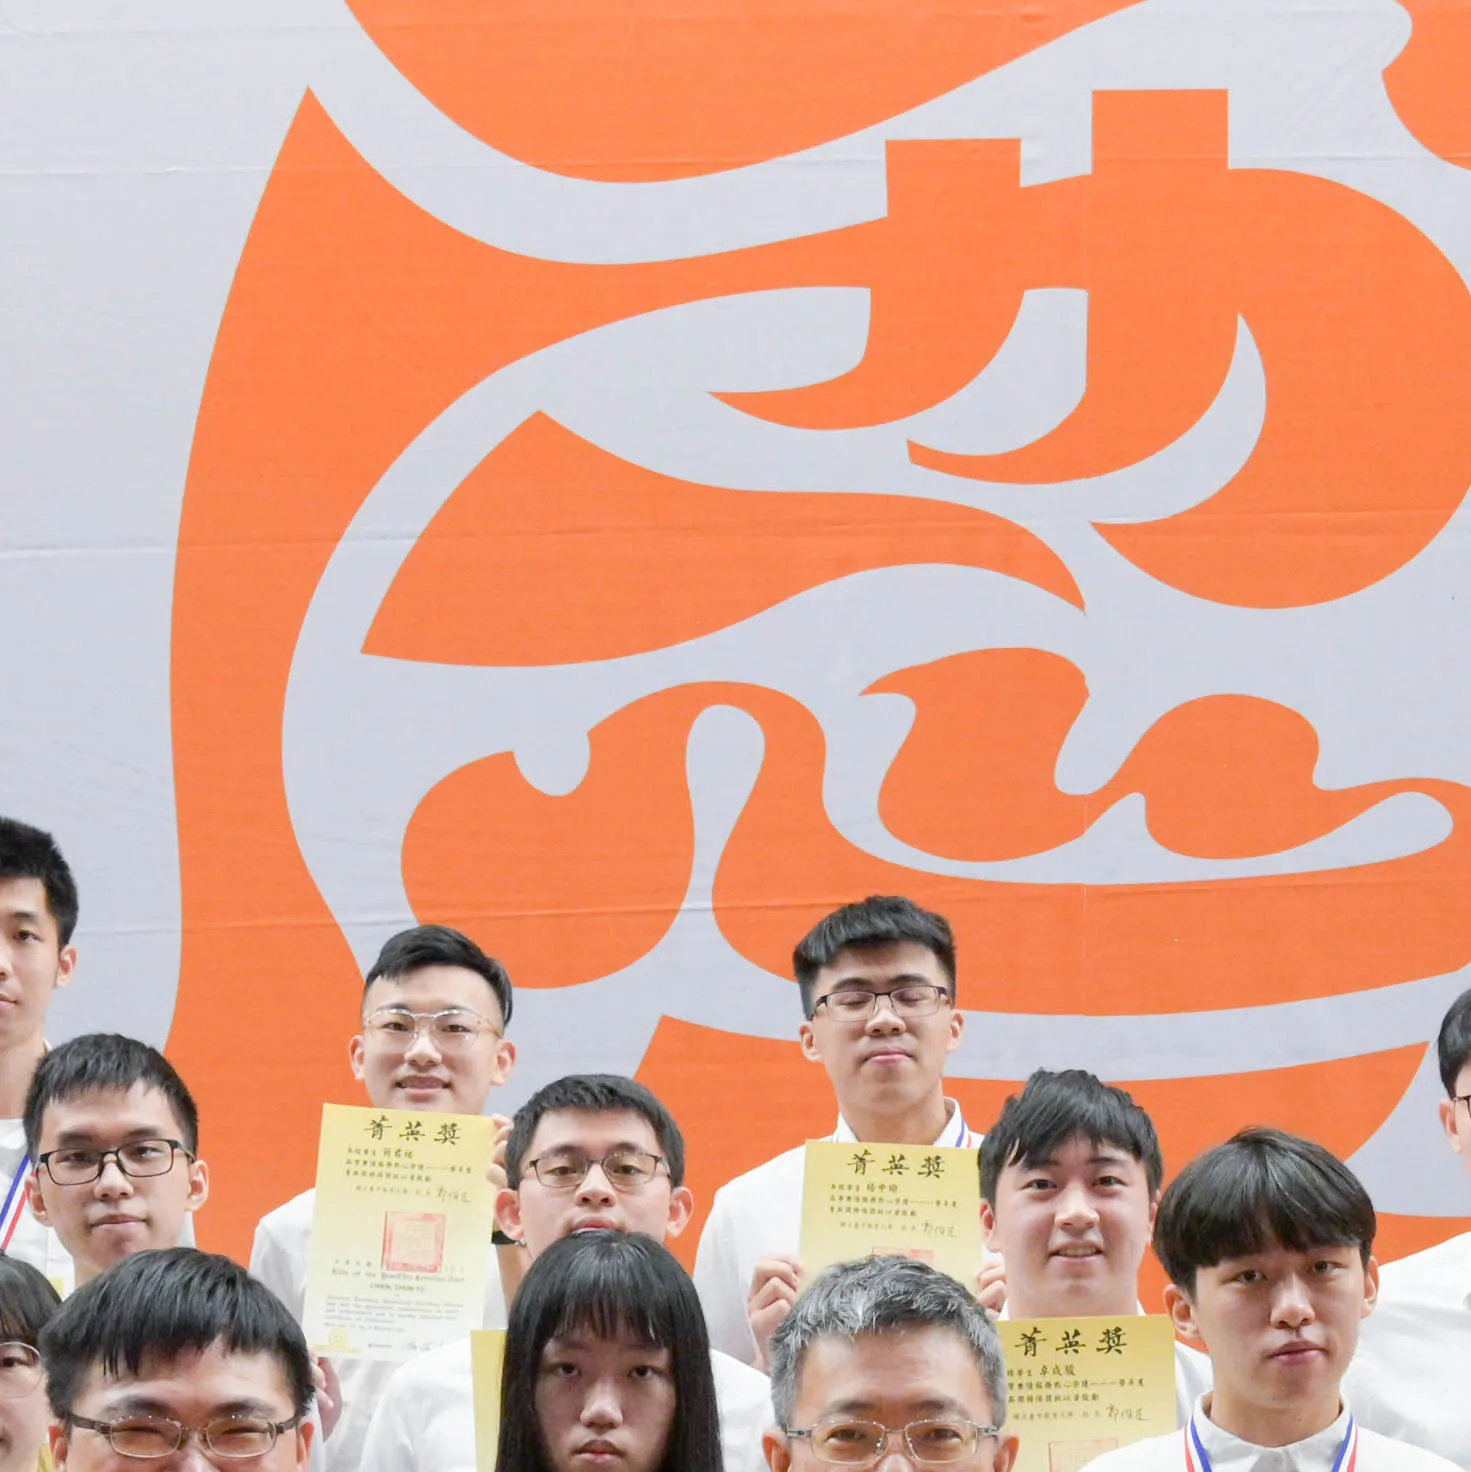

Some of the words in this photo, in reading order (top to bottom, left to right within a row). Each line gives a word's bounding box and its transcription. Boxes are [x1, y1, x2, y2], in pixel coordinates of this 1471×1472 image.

[364, 1114, 460, 1145] 菁英獎
[847, 1149, 944, 1178] 菁英獎
[1014, 1326, 1126, 1357] 菁英獎
